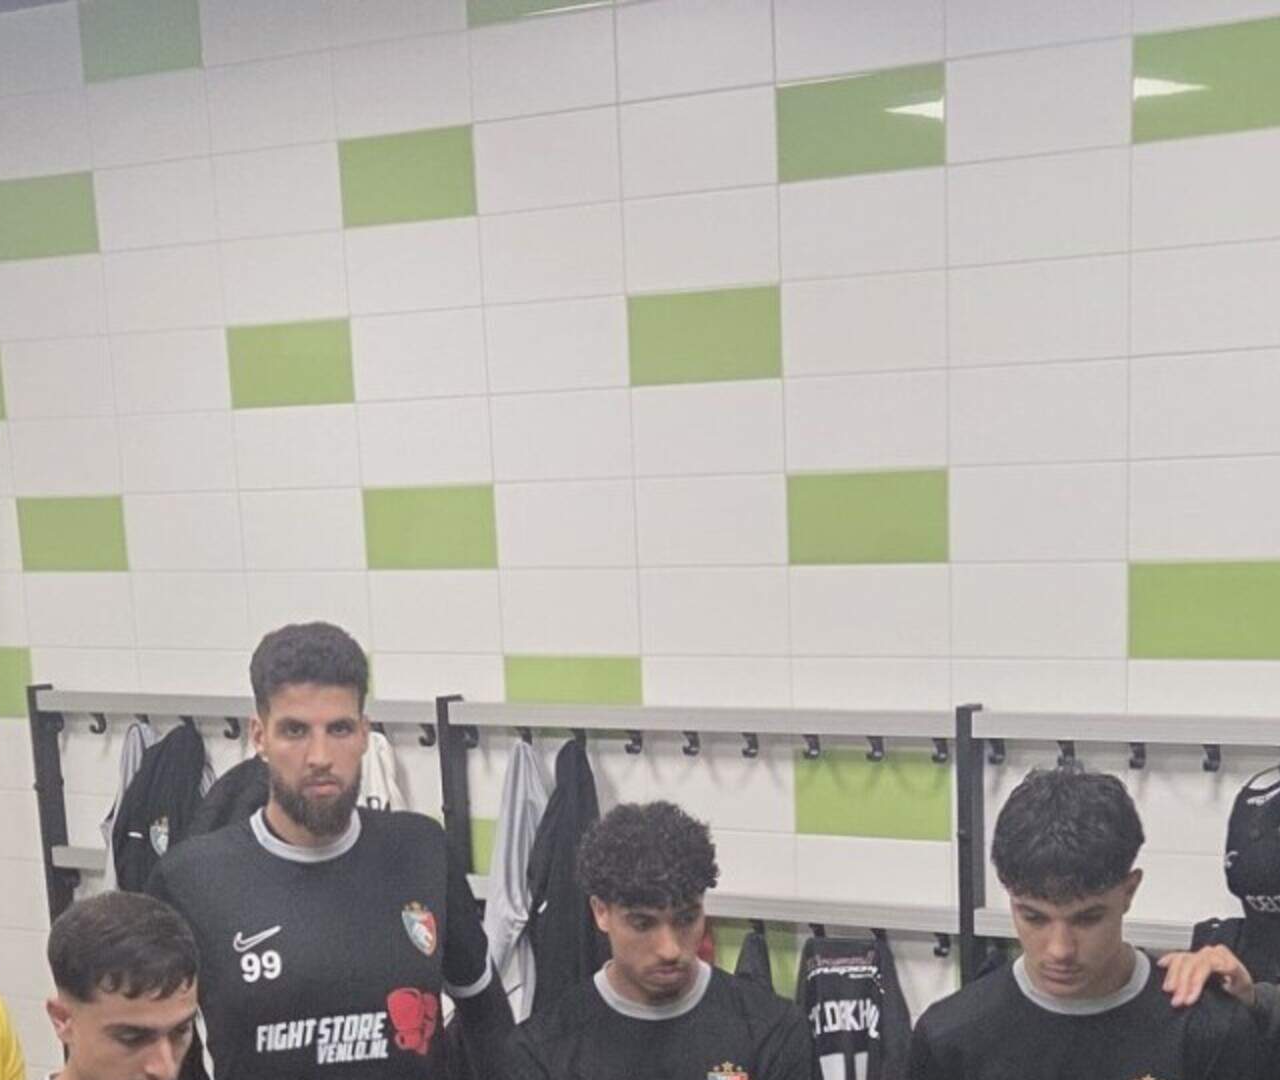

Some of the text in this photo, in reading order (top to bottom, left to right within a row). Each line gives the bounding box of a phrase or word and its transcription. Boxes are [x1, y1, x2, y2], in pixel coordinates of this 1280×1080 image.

[241, 950, 282, 982] 99
[257, 1011, 387, 1052] FIGHT STORE
[317, 1038, 388, 1064] VENLO.NL
